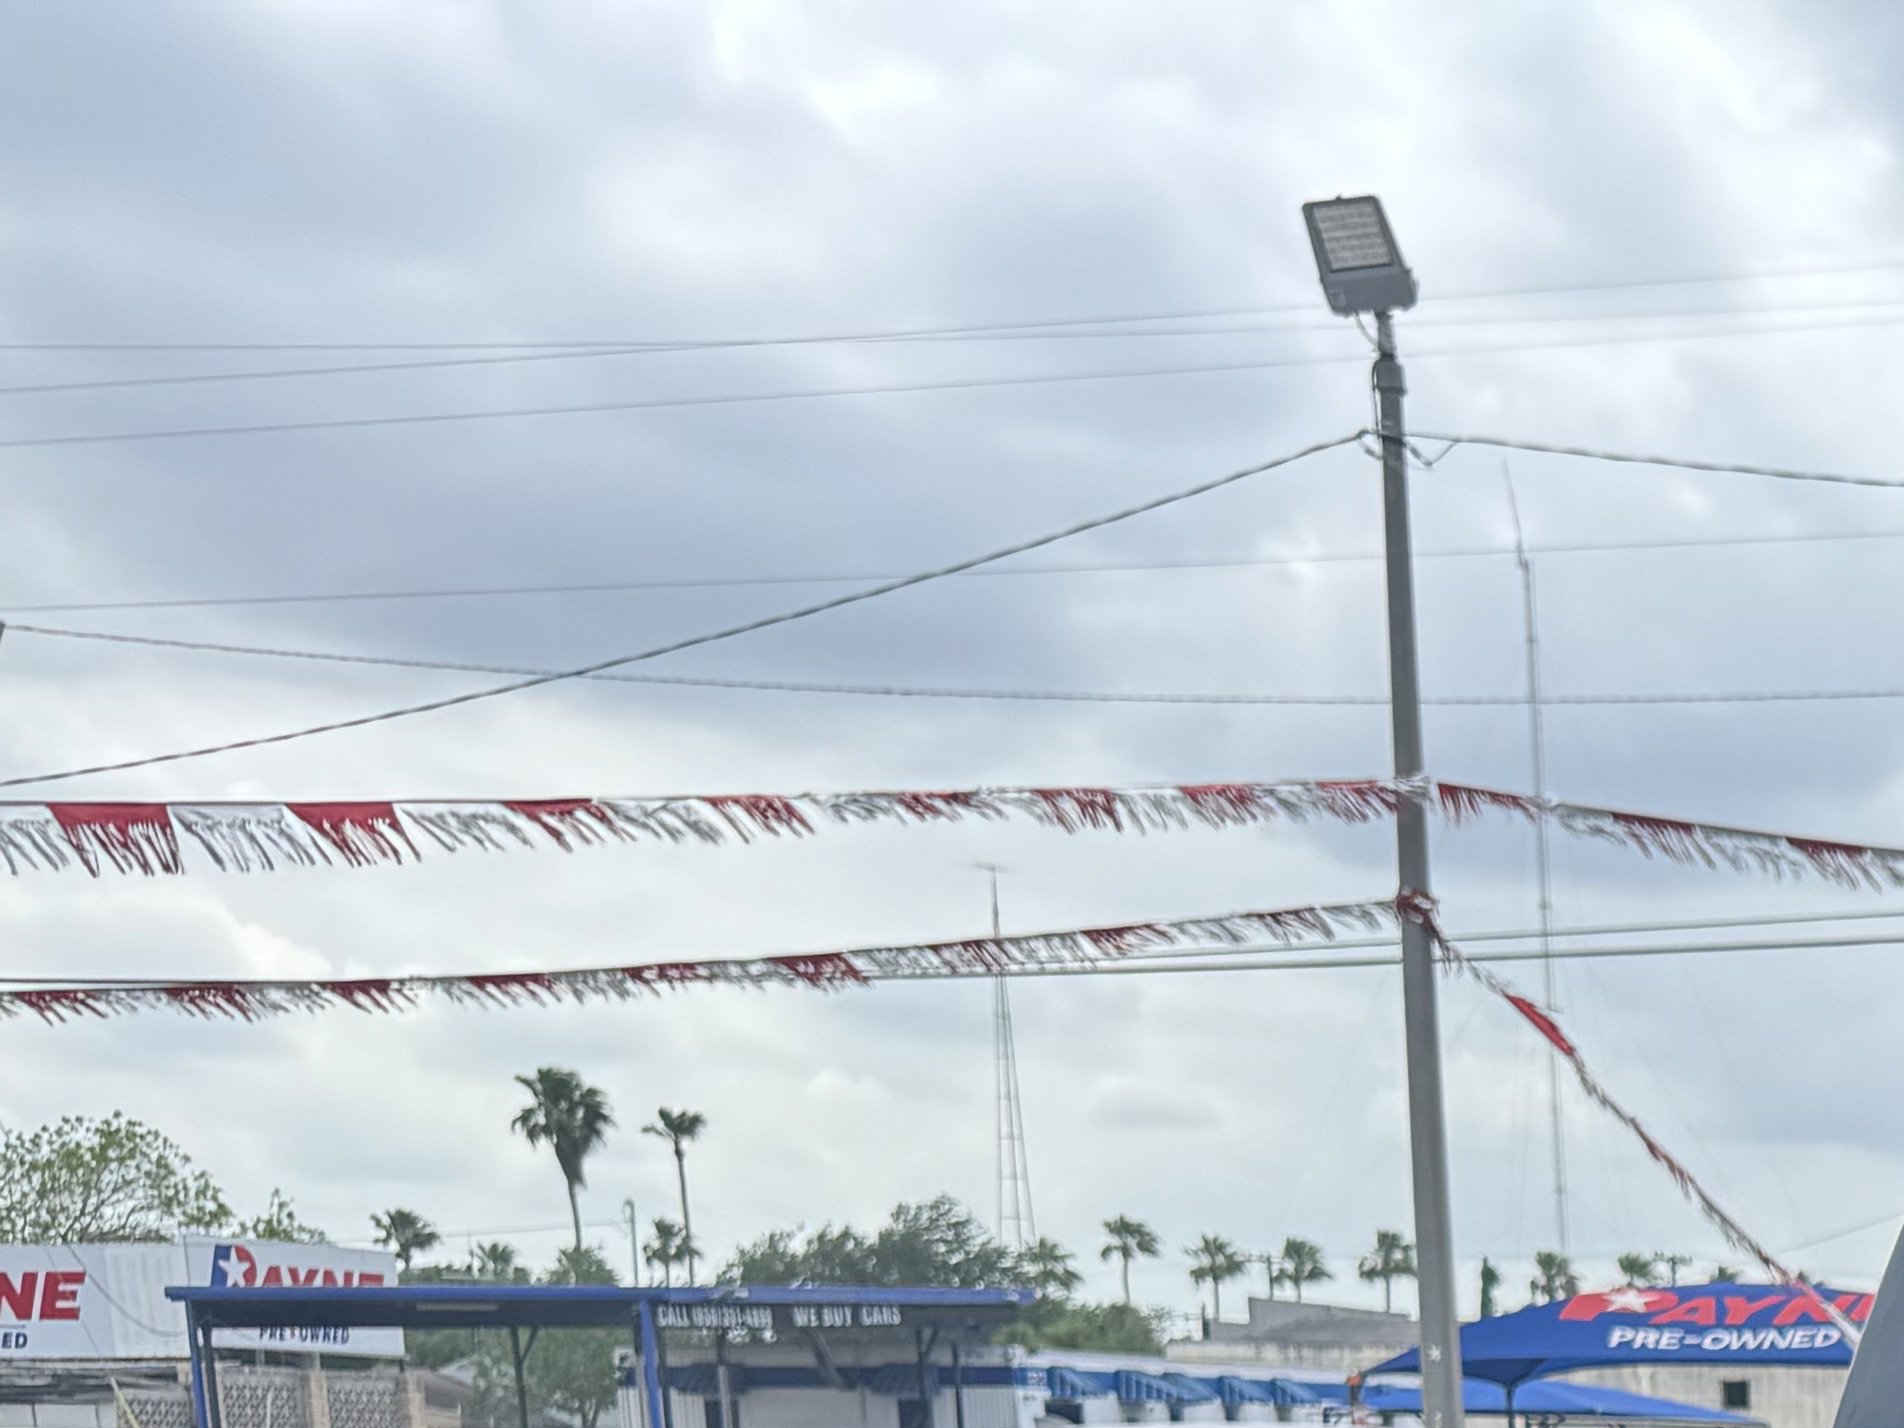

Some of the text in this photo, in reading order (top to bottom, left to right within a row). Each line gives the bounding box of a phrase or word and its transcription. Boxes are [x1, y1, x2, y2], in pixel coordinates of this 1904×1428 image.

[657, 1305, 690, 1328] CALL
[793, 1305, 819, 1328] WE
[822, 1305, 852, 1327] BUY
[860, 1304, 901, 1326] CARS
[1607, 1325, 1842, 1350] PRE-OWNED
